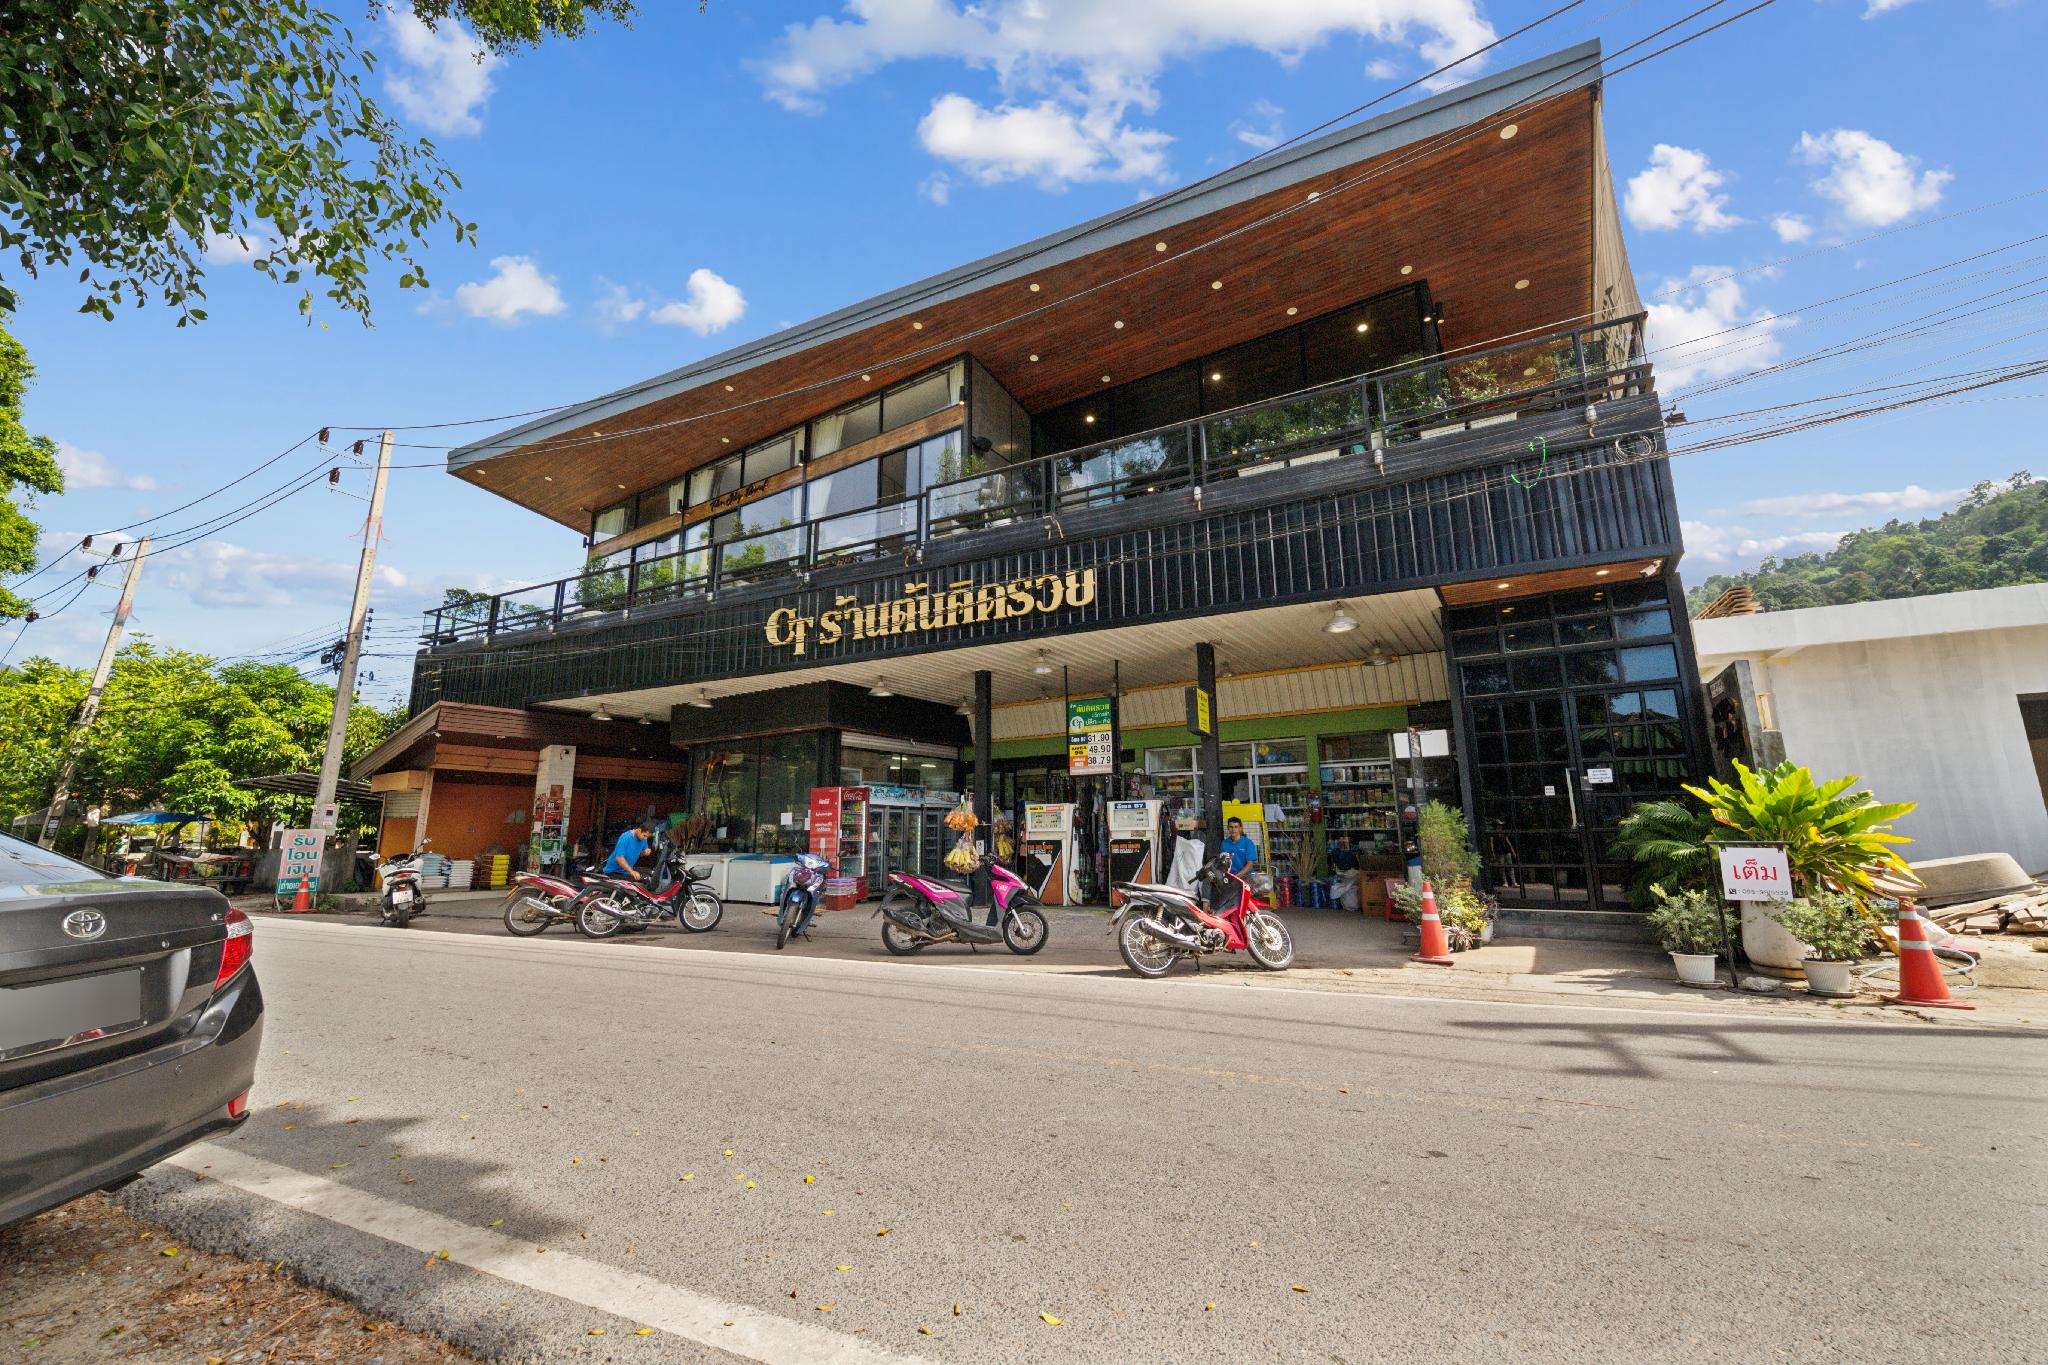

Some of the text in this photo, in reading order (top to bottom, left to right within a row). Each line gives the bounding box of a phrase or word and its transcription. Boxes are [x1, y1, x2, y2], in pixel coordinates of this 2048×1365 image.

[293, 834, 317, 846] รับ
[287, 848, 318, 860] โอน
[1733, 859, 1778, 880] เต็ม
